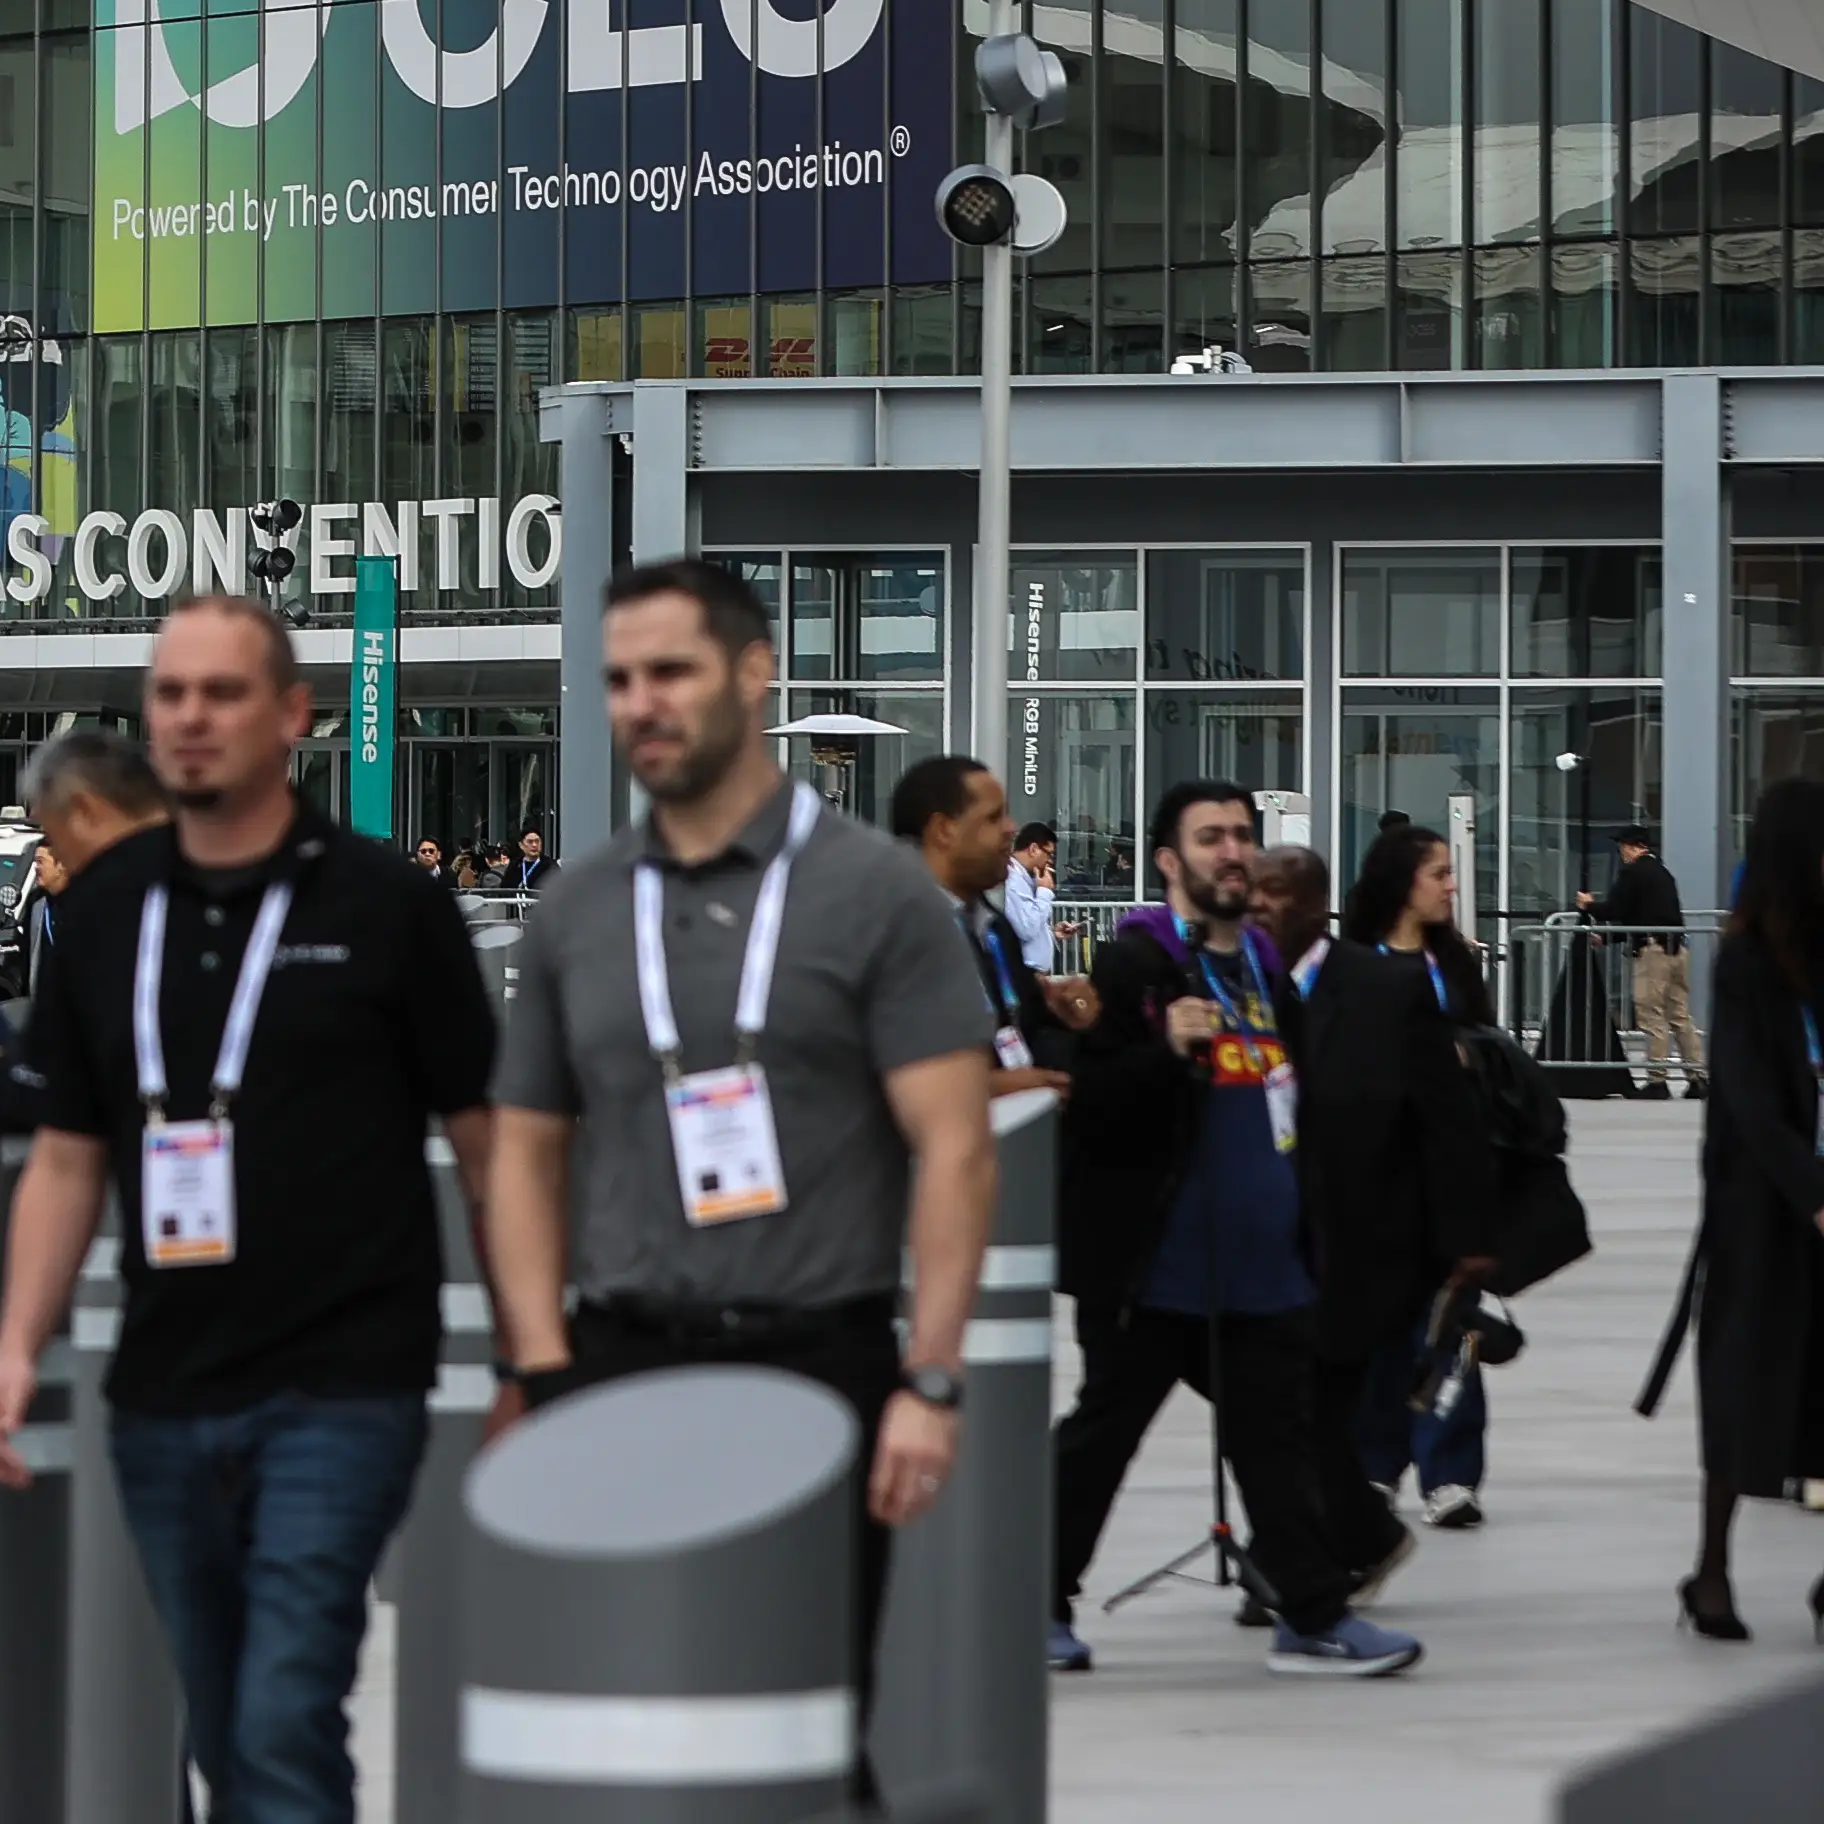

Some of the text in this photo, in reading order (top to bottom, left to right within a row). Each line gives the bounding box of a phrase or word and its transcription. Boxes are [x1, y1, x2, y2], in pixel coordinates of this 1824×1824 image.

[113, 188, 235, 241] Powered
[243, 188, 278, 242] by
[281, 182, 338, 228] The
[345, 178, 498, 224] Consumer
[508, 162, 687, 213] Technoogy
[1026, 582, 1045, 681] Hisense
[362, 631, 385, 764] Hisense
[1025, 697, 1040, 734] RGB
